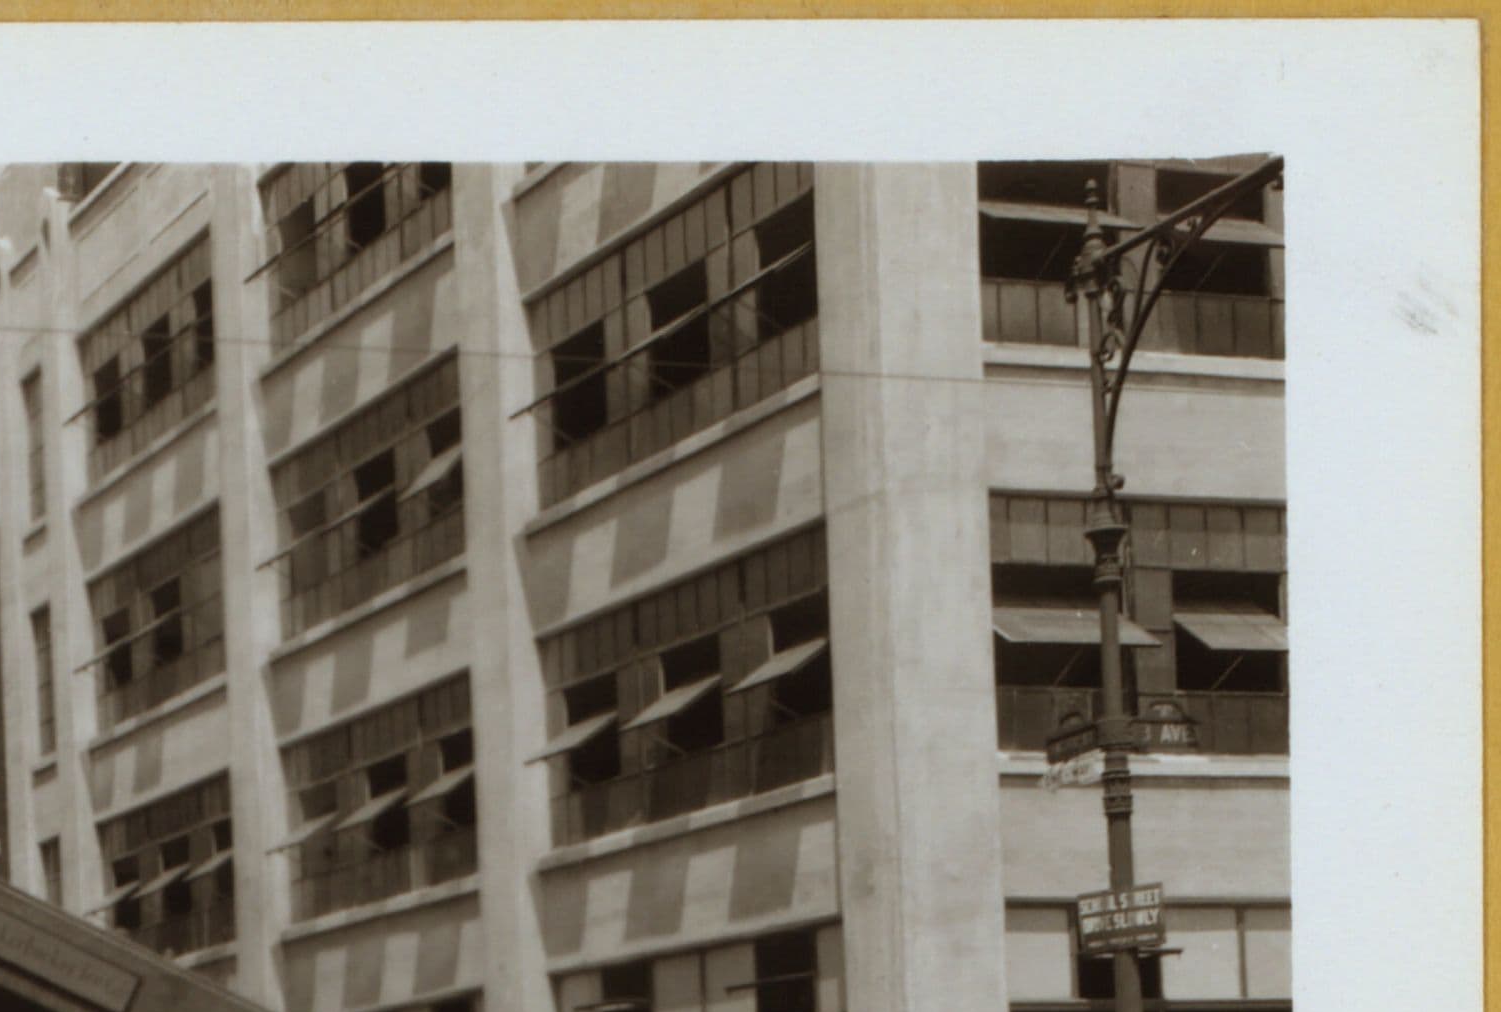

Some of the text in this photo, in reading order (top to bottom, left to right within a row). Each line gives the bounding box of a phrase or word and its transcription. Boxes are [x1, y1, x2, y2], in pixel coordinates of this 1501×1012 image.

[1159, 724, 1195, 745] AVE
[1079, 888, 1160, 914] SCHL SREET
